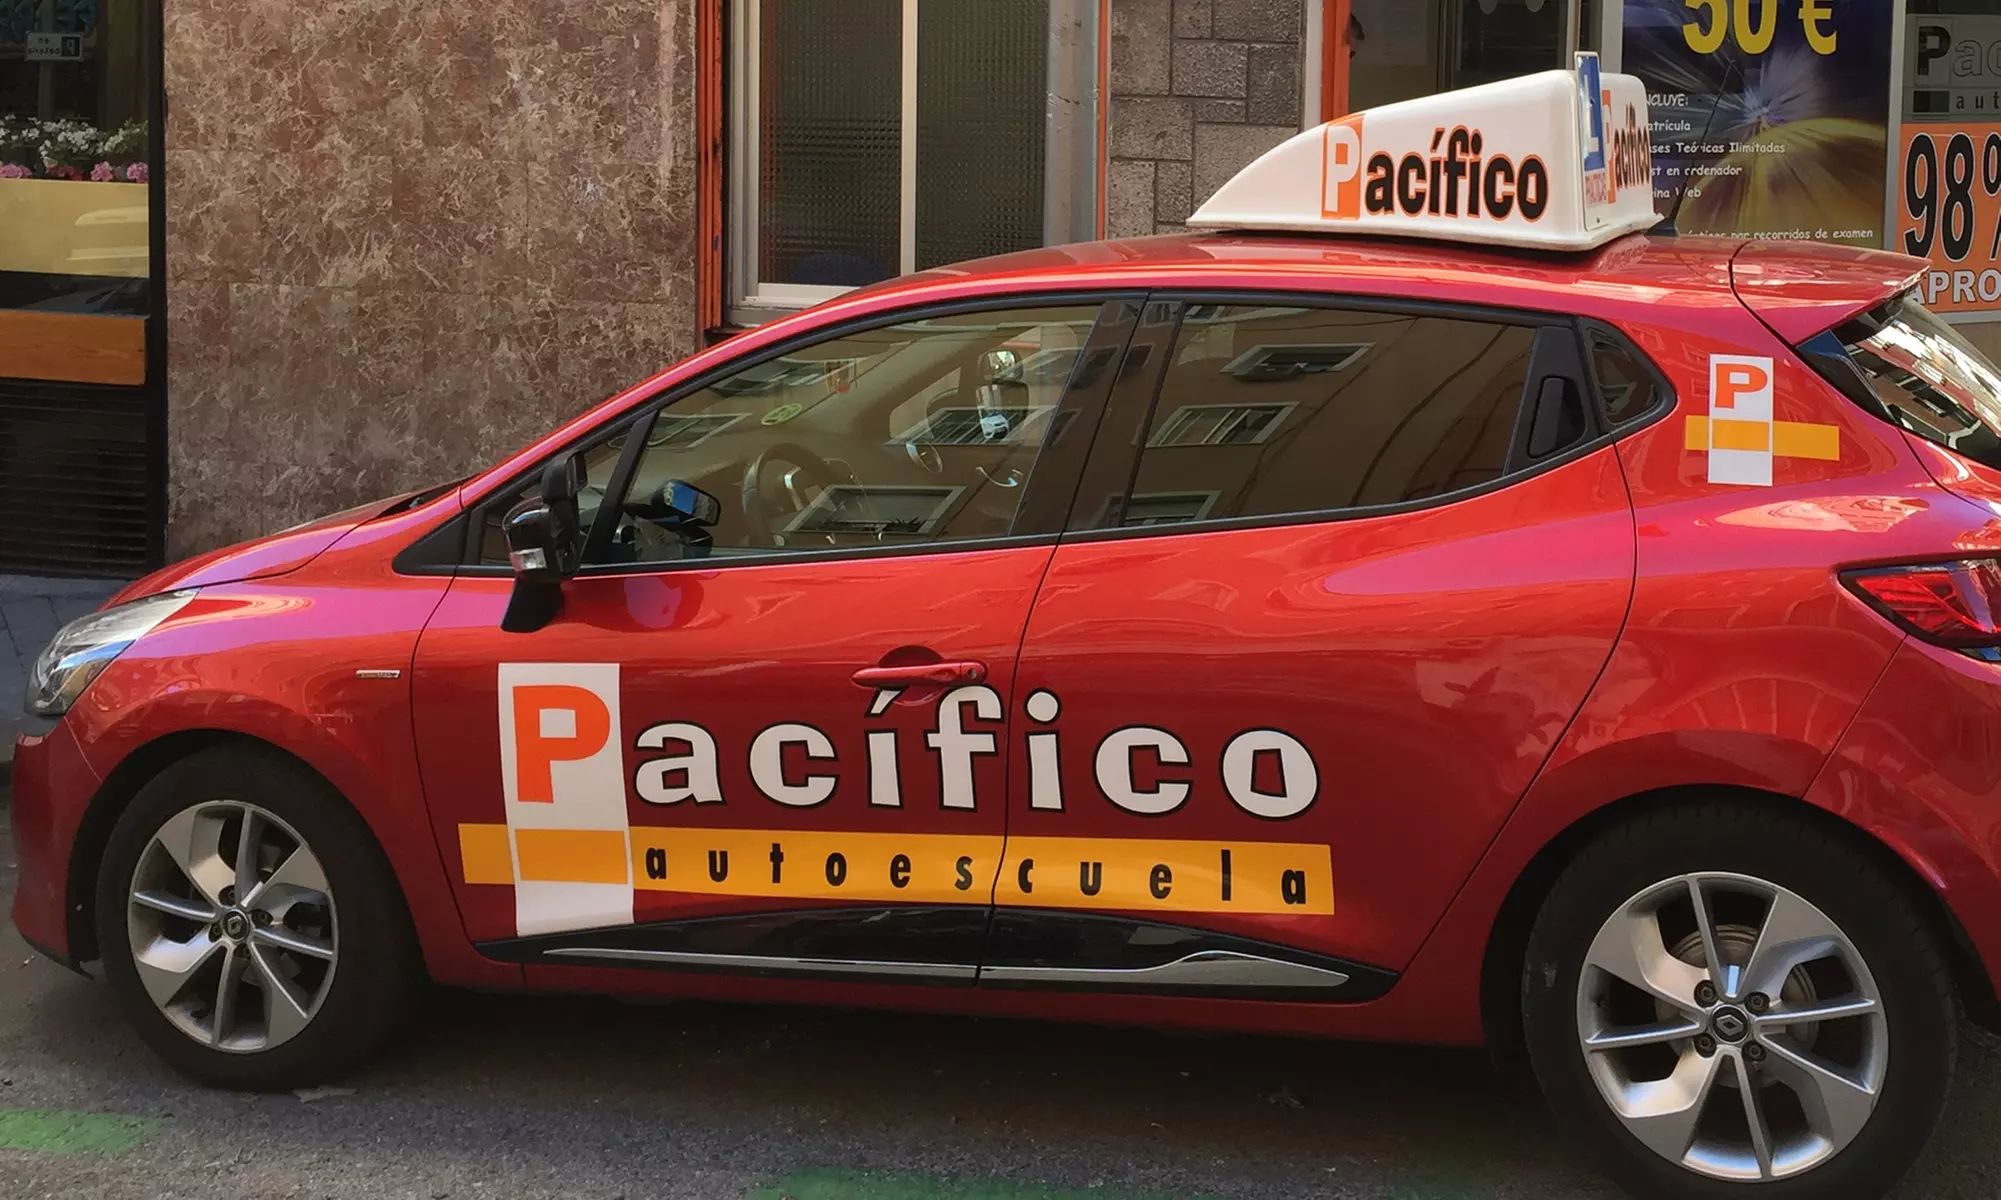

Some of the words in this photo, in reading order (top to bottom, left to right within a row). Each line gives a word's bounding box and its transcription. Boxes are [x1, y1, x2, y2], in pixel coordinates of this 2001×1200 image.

[1646, 93, 1689, 106] NCLUYE:
[1648, 119, 1691, 131] atrícula
[1729, 142, 1785, 153] Ilimitadas
[1324, 124, 1549, 223] Pacífico
[1666, 168, 1680, 176] en
[1685, 166, 1742, 176] ordenador
[1754, 227, 1810, 239] recorridos
[1815, 227, 1827, 238] de
[1833, 229, 1873, 238] examen
[1714, 363, 1768, 409] P
[513, 684, 1320, 821] Pacífico
[645, 843, 1306, 906] autoescuela
